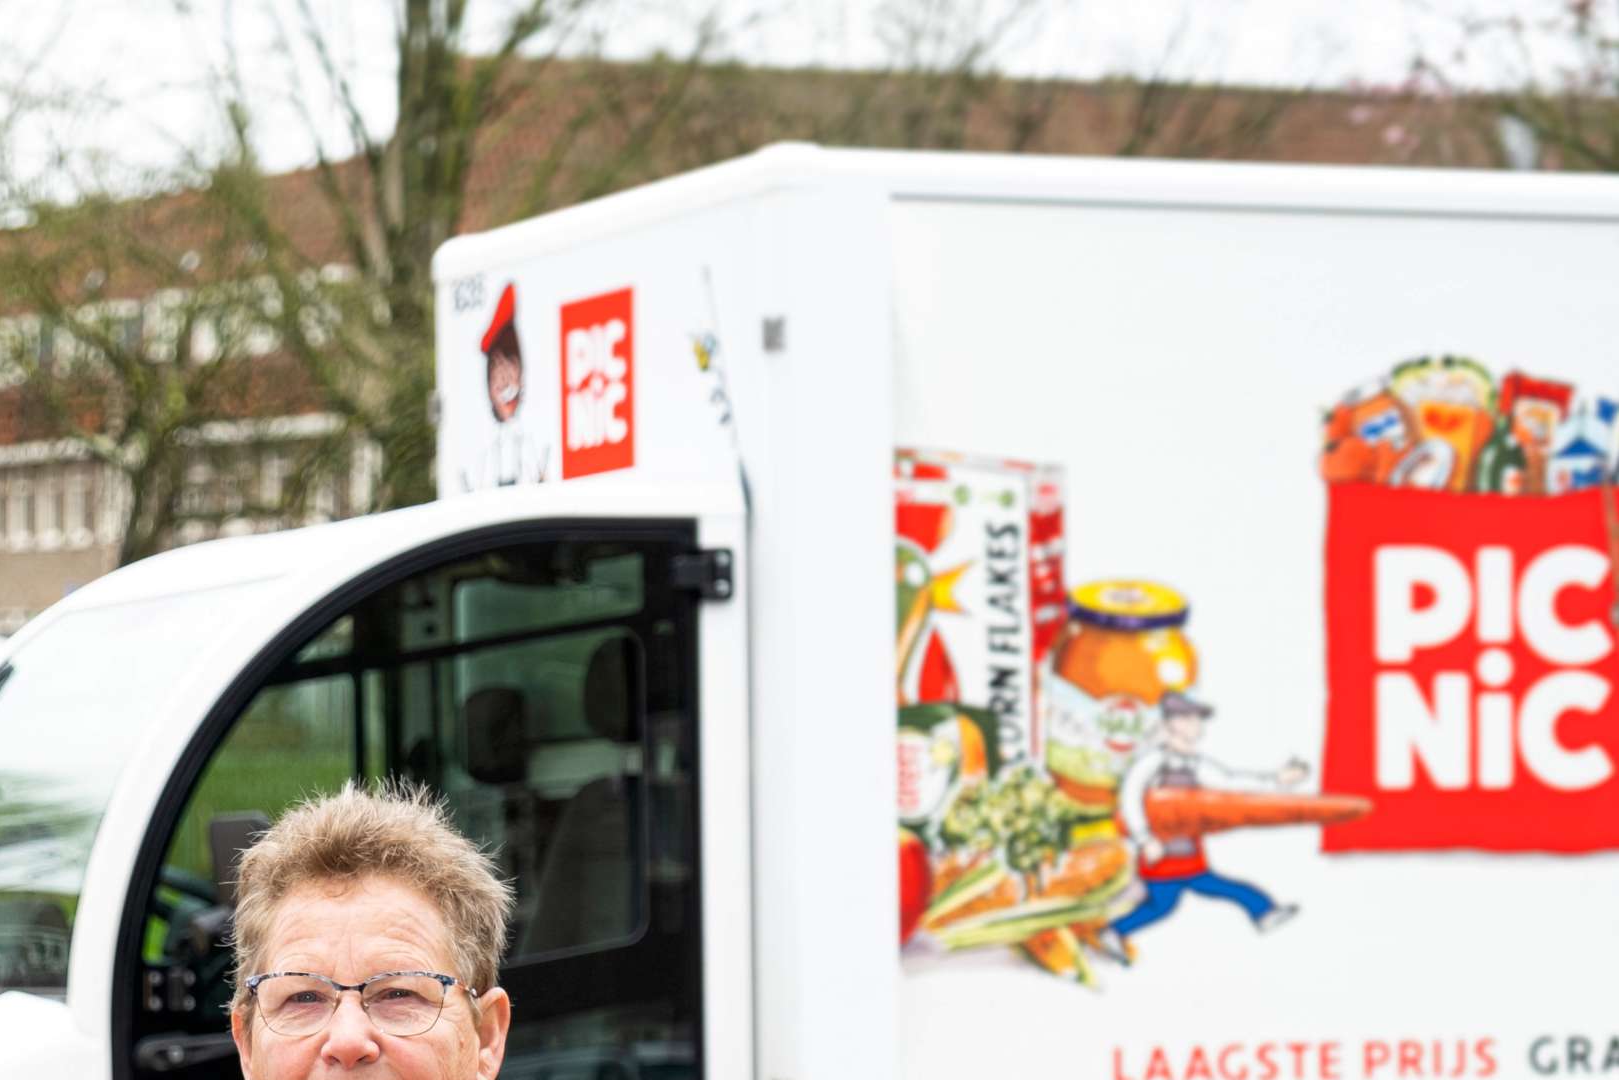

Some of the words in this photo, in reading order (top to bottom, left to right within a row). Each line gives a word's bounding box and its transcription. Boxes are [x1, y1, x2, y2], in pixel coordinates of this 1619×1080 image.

[985, 521, 1021, 656] FLAKES
[1374, 543, 1613, 665] PIC
[1363, 1036, 1498, 1079] PRIJS
